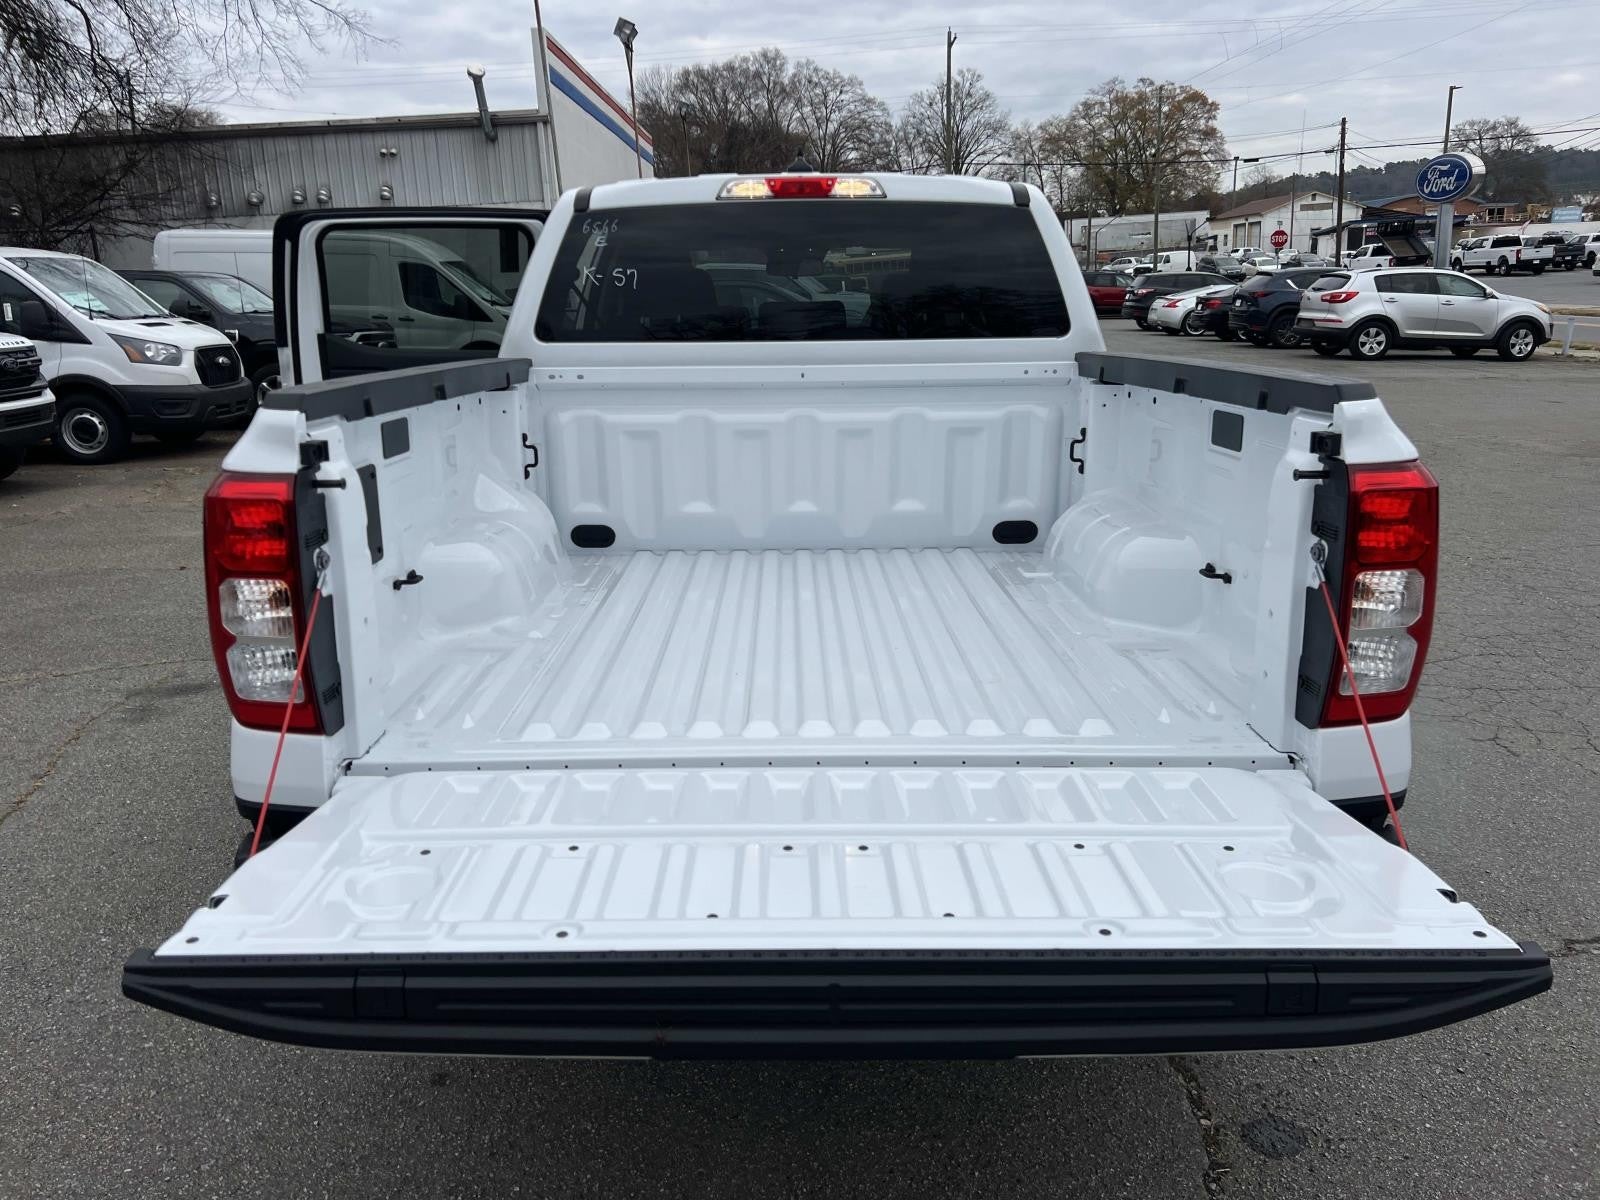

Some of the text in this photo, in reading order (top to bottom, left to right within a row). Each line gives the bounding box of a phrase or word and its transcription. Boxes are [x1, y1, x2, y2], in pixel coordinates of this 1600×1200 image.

[1423, 163, 1459, 194] Ford
[582, 219, 619, 234] 6566
[594, 235, 608, 247] E
[1271, 235, 1288, 243] STOP
